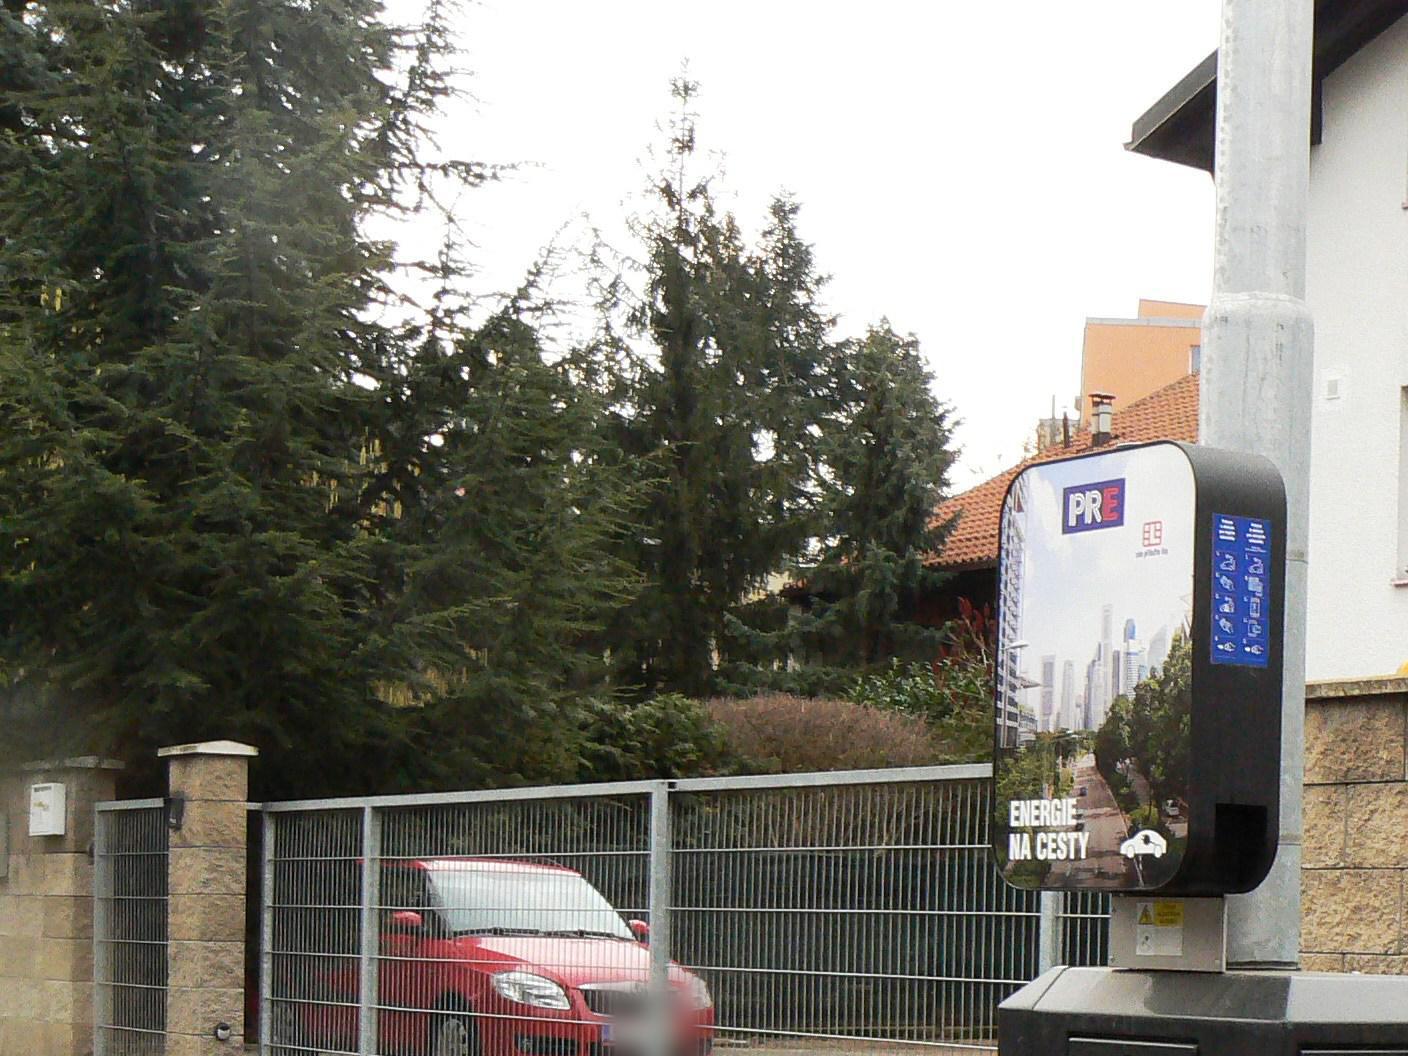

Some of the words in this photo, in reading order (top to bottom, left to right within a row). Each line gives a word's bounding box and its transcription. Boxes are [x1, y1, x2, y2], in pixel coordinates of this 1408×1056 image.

[1068, 486, 1121, 527] PRE
[1010, 798, 1077, 827] ENERGIE
[1008, 832, 1032, 860] NA
[1036, 831, 1089, 861] CESTY
